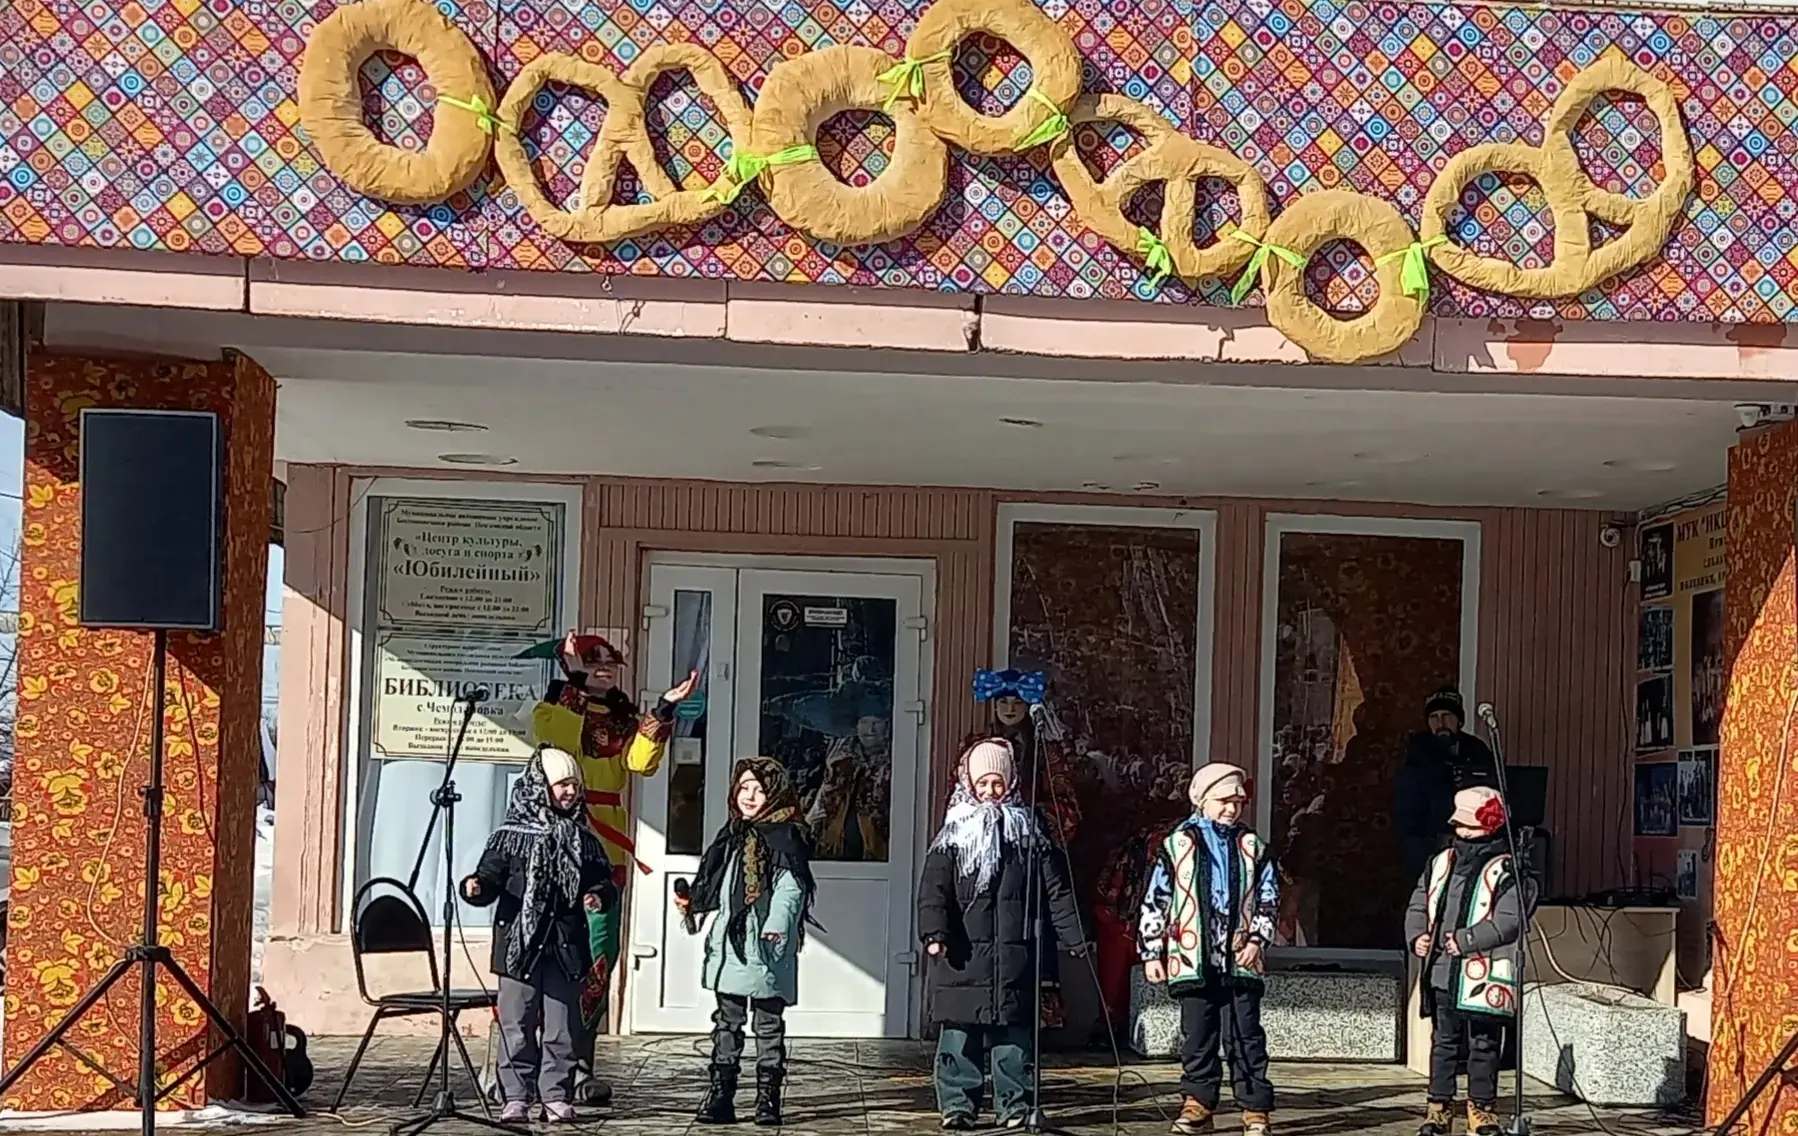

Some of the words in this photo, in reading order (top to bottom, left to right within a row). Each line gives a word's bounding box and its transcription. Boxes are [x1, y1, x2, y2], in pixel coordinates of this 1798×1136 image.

[415, 532, 459, 546] «Центр
[464, 548, 471, 557] и
[474, 549, 514, 561] спорта
[393, 560, 540, 582] «Юбилейный»
